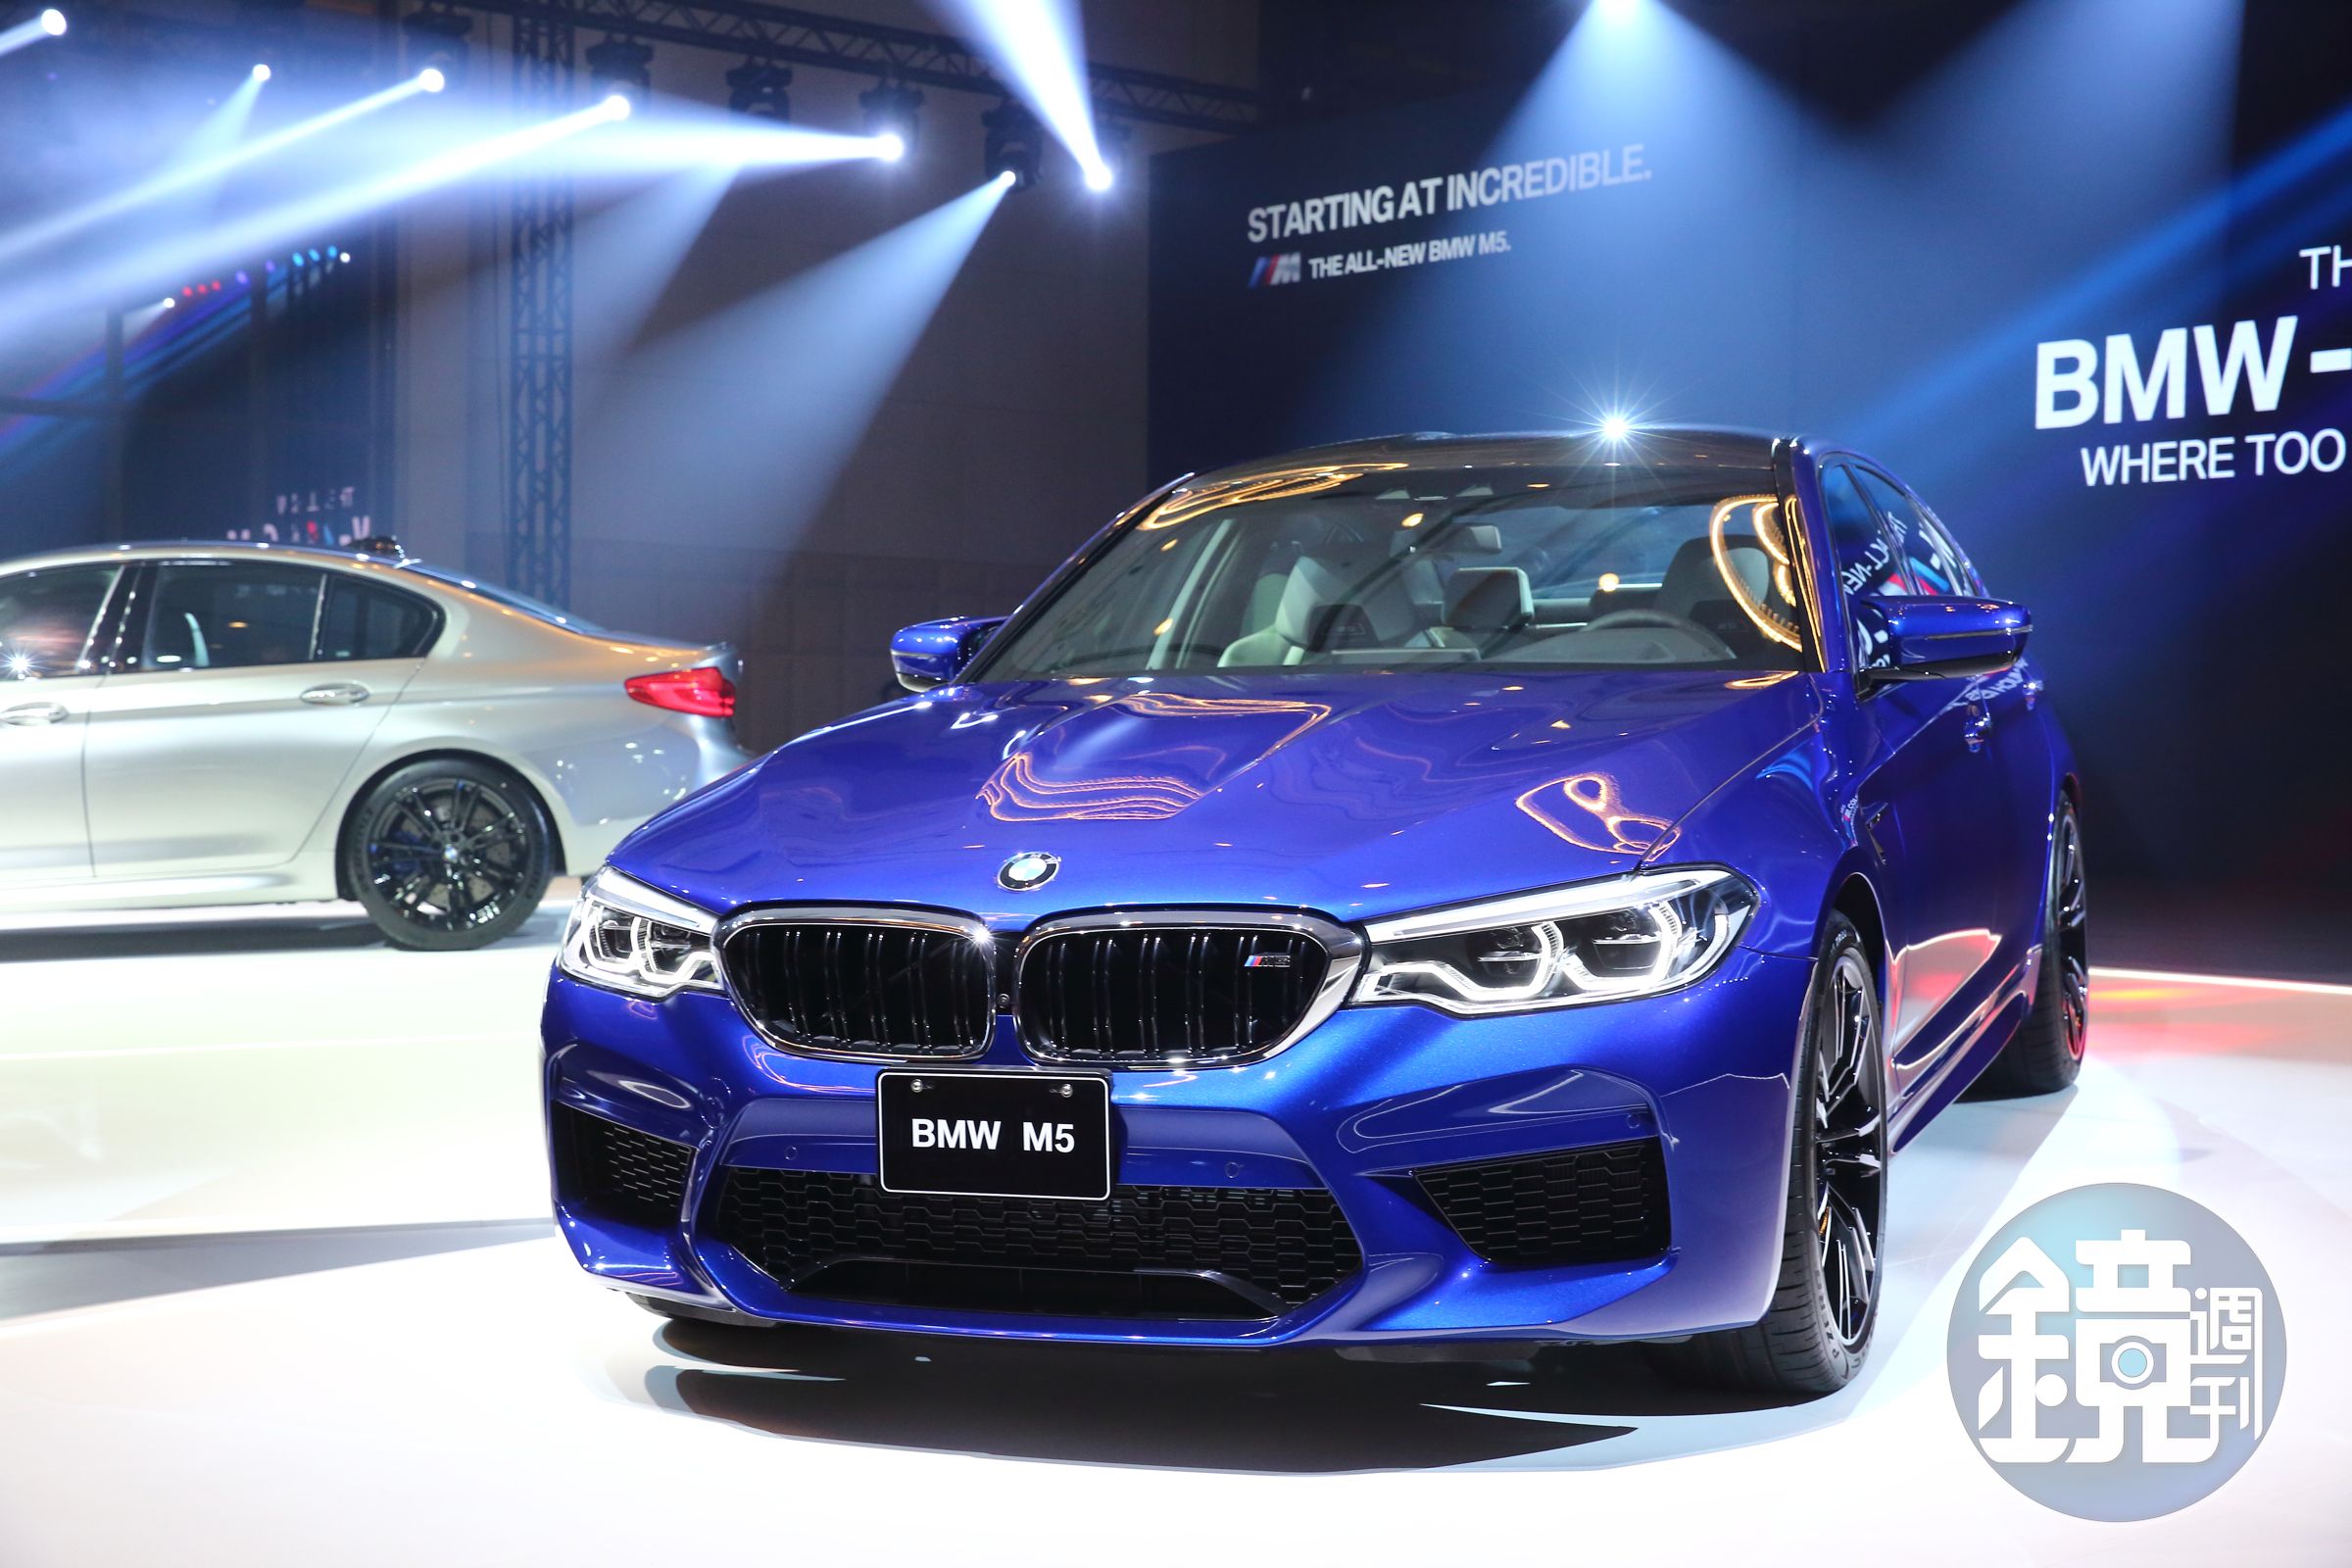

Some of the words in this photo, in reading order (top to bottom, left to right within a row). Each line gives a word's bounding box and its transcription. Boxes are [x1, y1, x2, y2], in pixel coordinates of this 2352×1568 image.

[1247, 183, 1394, 243] STARTING
[1397, 176, 1444, 220] AT
[1446, 143, 1653, 212] INCREDIBLE.
[1308, 255, 1344, 279] THE
[1345, 242, 1427, 274] ALL-NEW
[1429, 234, 1476, 263] BMW
[1478, 230, 1512, 255] M5.
[2035, 315, 2299, 430] BMW
[2081, 436, 2235, 487] WHERE
[2244, 427, 2346, 476] TOO
[910, 1118, 1002, 1151] BMW
[1022, 1121, 1075, 1153] M5
